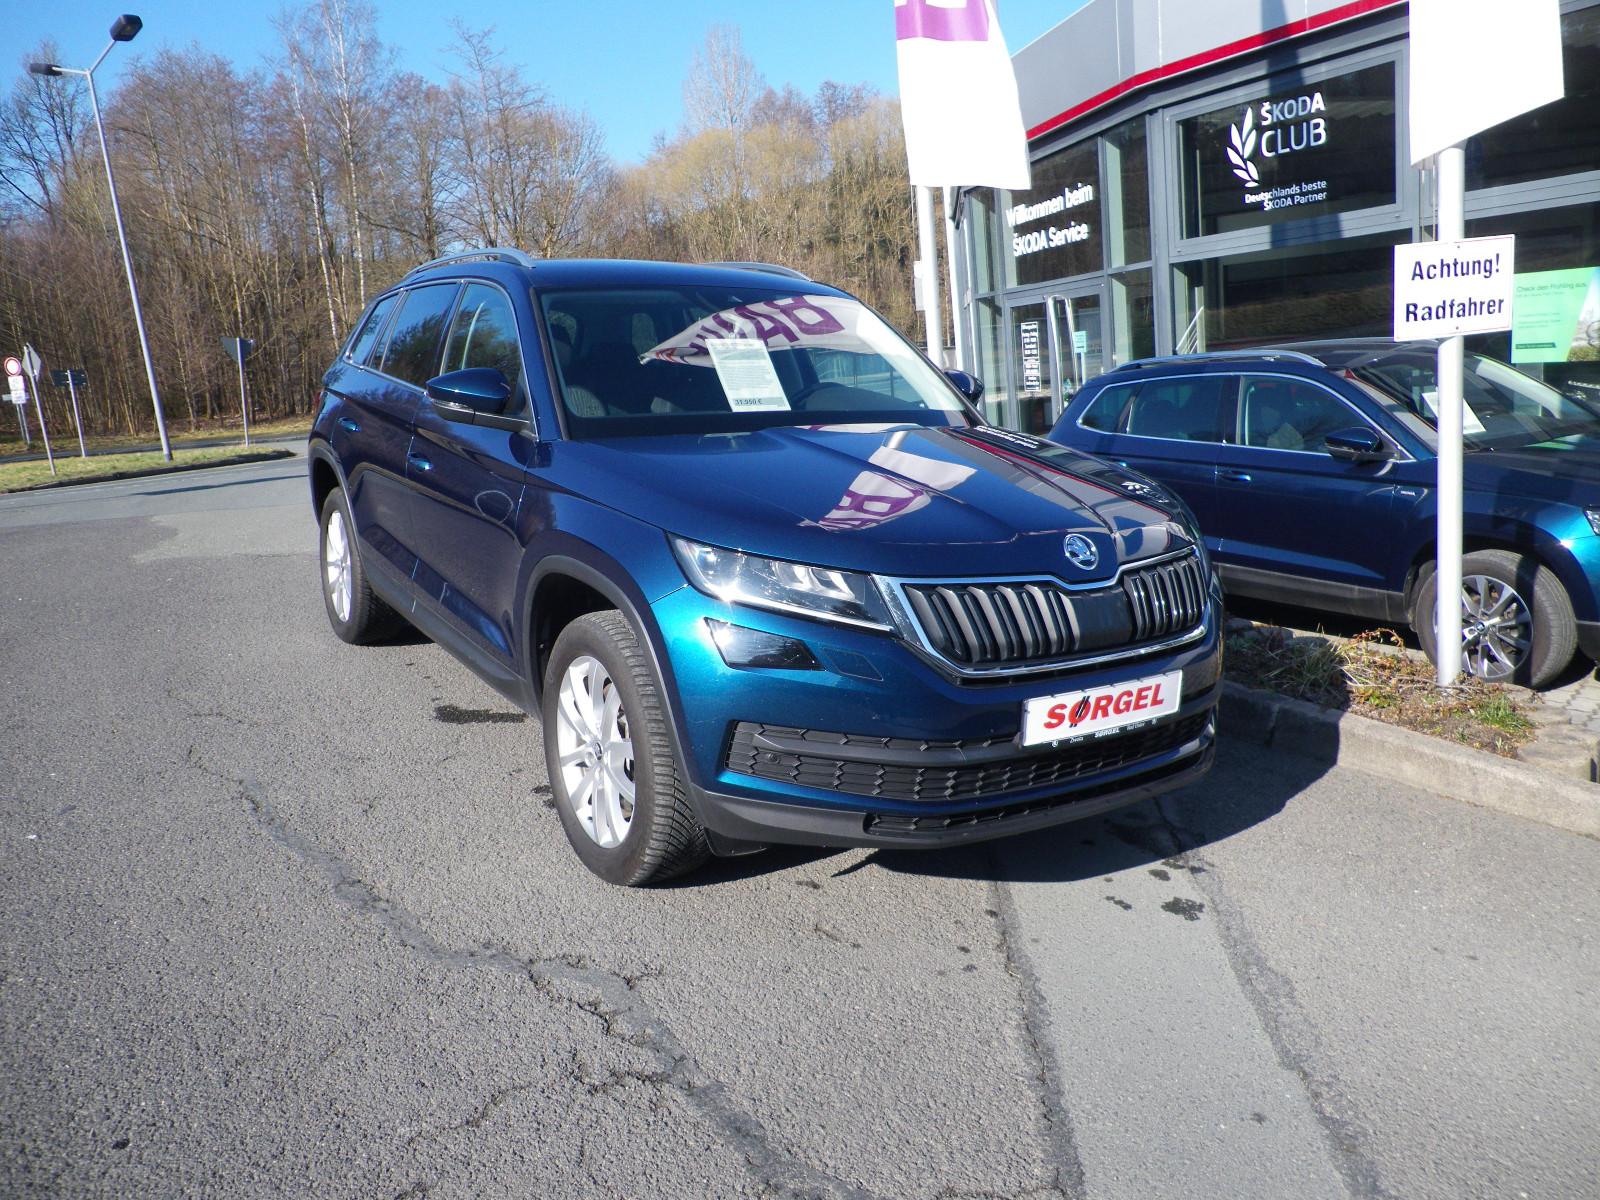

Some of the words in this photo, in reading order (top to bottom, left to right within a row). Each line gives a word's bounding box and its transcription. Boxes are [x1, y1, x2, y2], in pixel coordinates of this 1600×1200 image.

[1260, 92, 1326, 126] ŠKODA
[1261, 117, 1327, 157] CLUB
[1006, 195, 1065, 227] Willkommen
[1065, 183, 1093, 208] beim
[1245, 185, 1300, 203] Deutschlands
[1302, 180, 1327, 192] beste
[1263, 197, 1293, 211] ŠKODA
[1294, 192, 1327, 205] Partner
[1012, 230, 1049, 257] ŠKODA
[1048, 221, 1089, 248] Service
[1411, 253, 1500, 281] Achtung!
[1405, 297, 1504, 322] Radfahrer
